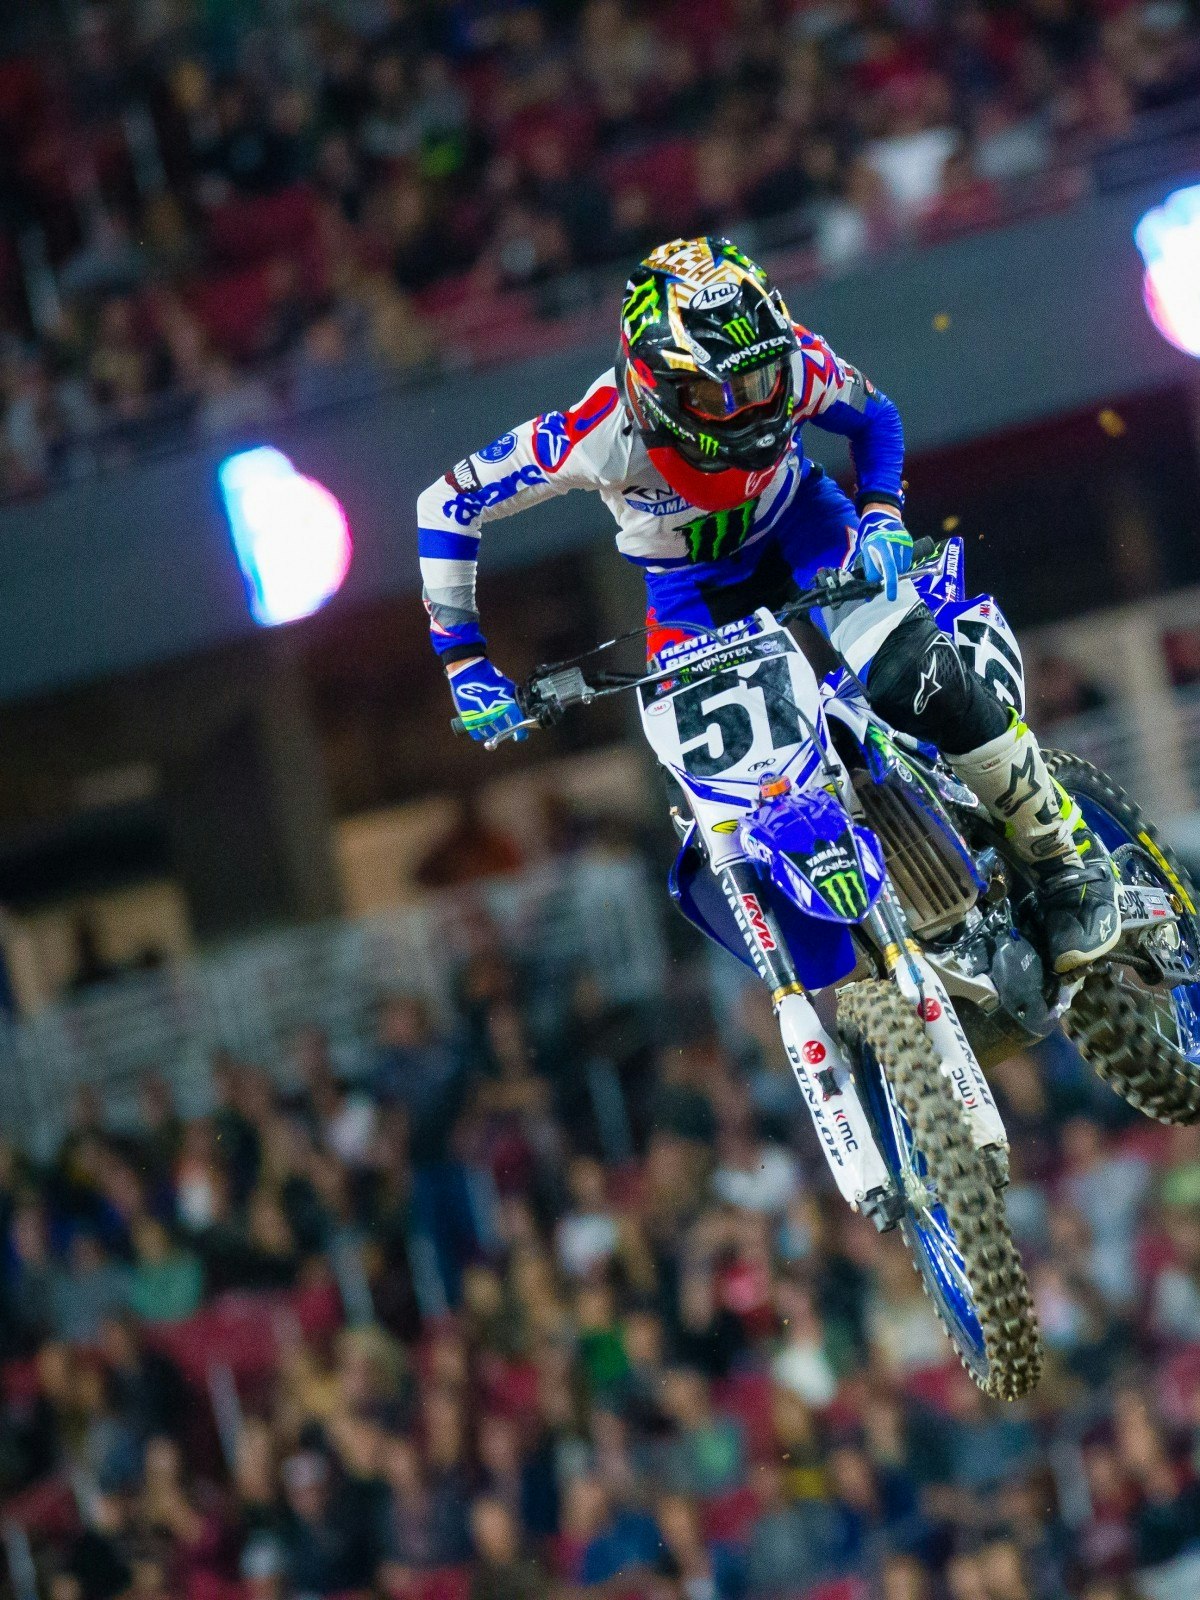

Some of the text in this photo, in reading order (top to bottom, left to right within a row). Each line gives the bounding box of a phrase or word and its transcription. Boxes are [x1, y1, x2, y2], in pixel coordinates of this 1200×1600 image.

[697, 283, 736, 306] Arai
[716, 336, 791, 373] MONSTER
[648, 499, 692, 516] YAMA
[946, 543, 961, 578] DUNLOP
[691, 646, 752, 672] MONSTER
[672, 656, 803, 776] 51
[805, 846, 848, 868] YAMAHA
[787, 1044, 844, 1167] DUNLOP
